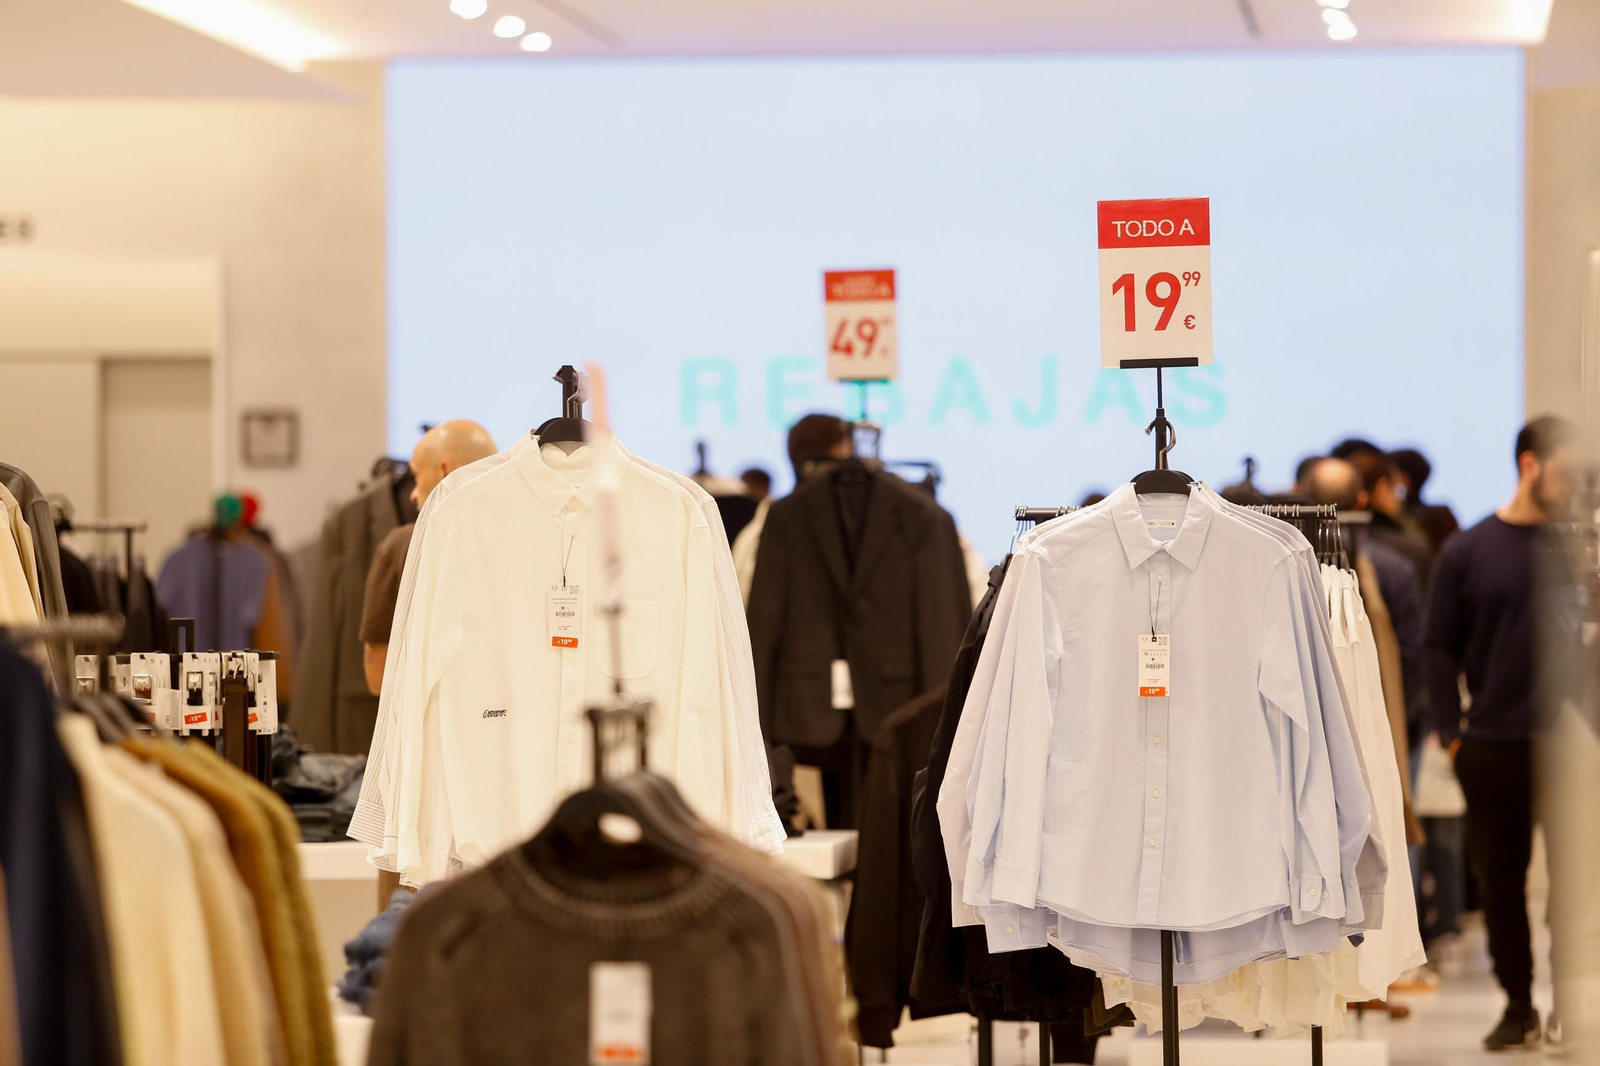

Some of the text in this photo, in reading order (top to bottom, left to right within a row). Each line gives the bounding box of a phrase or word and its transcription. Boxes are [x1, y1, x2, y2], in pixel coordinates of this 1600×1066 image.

[1112, 218, 1195, 237] TODO A
[1112, 271, 1182, 332] 19
[1183, 314, 1196, 330] €
[831, 318, 879, 358] 49
[679, 354, 1227, 429] REBAJAS
